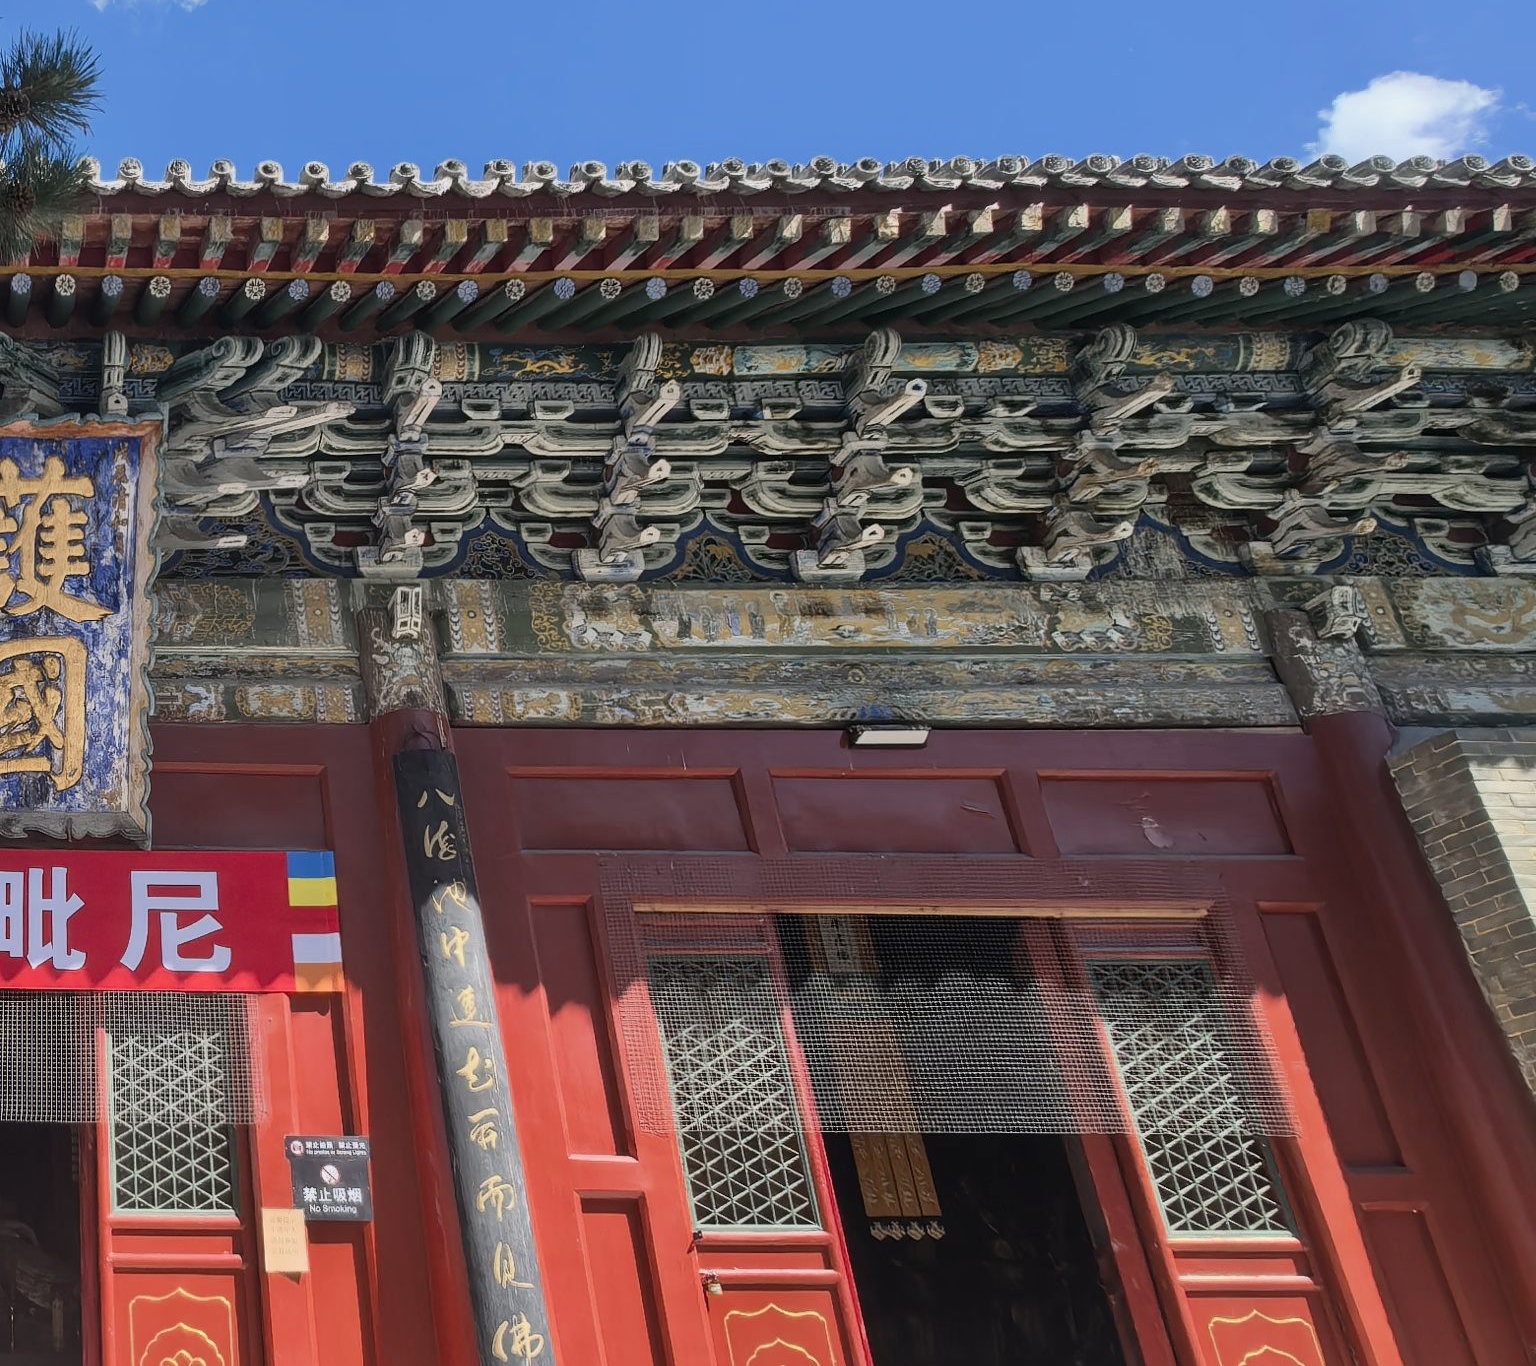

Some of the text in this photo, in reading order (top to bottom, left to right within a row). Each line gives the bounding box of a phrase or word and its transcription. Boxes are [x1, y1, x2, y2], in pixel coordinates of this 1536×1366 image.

[302, 1186, 363, 1203] 禁止吸烟
[309, 1204, 357, 1214] No Smoking
